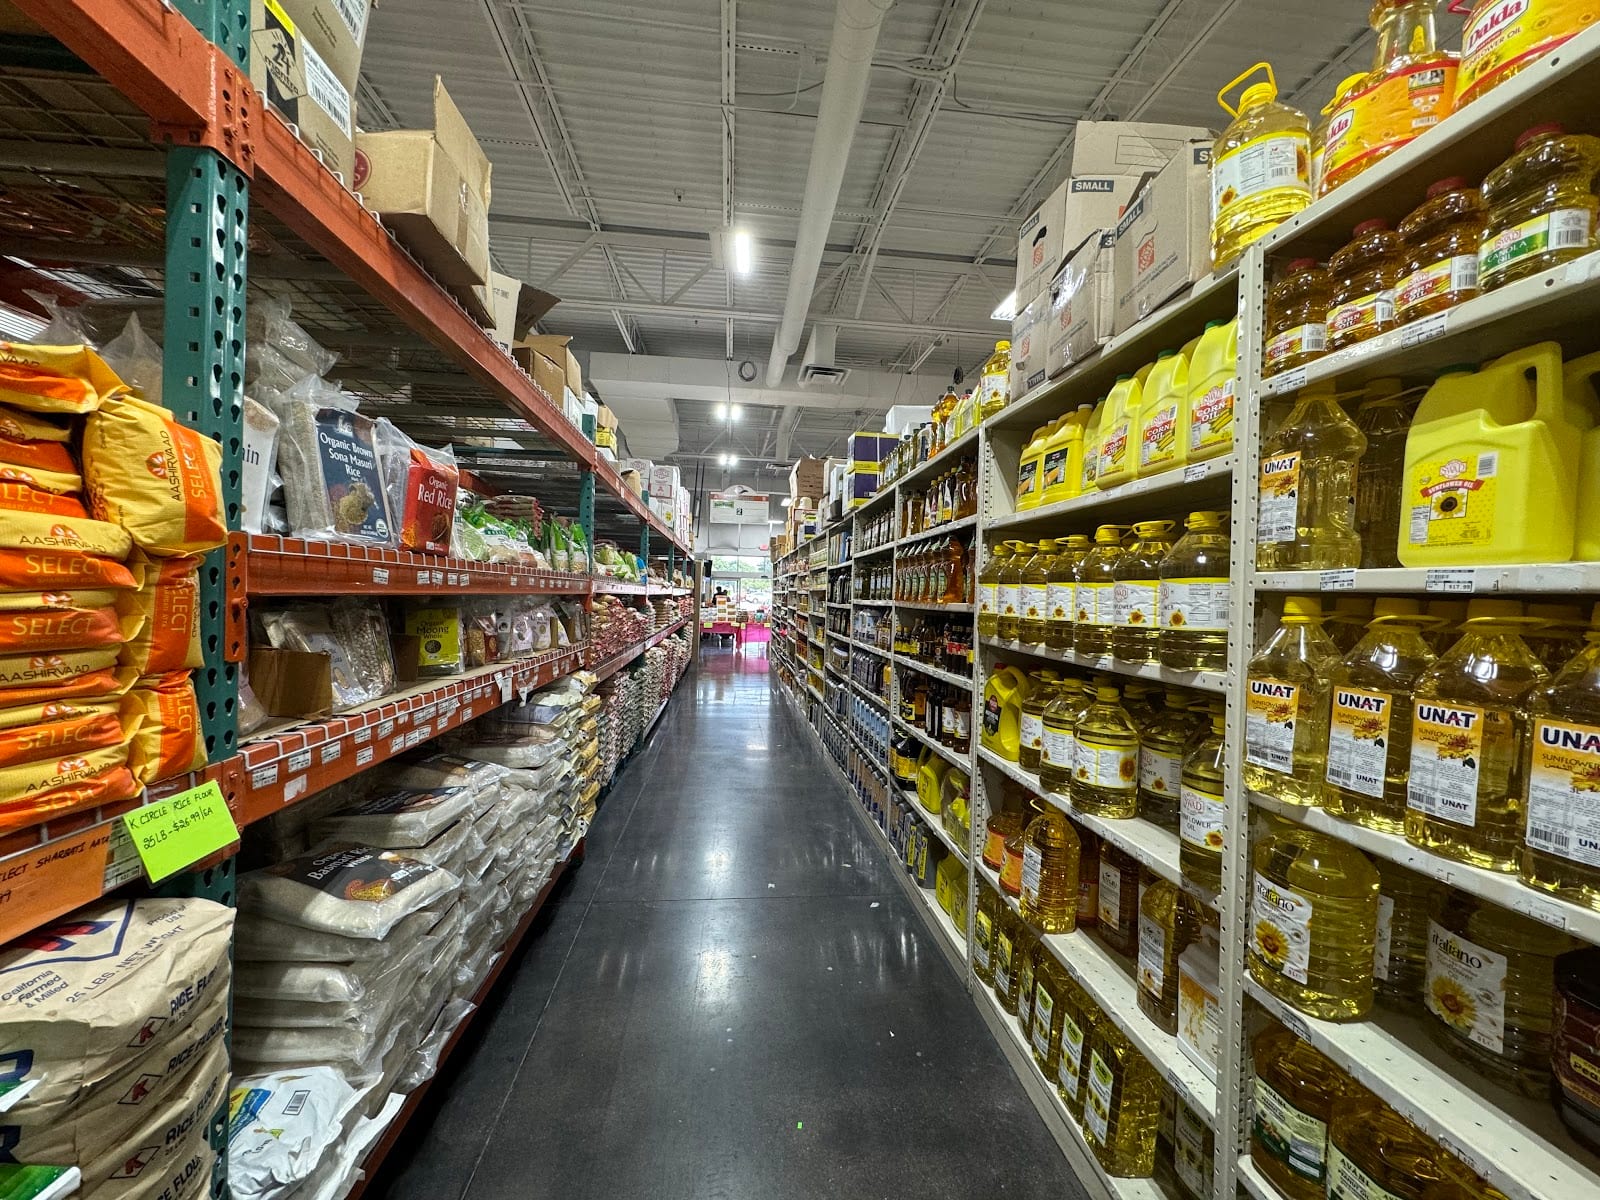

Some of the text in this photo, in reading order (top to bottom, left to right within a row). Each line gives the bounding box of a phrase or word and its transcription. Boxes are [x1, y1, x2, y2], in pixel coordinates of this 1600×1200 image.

[1507, 27, 1522, 39] OIL
[1075, 182, 1110, 191] SMALL
[1117, 204, 1143, 236] SMALL
[1403, 281, 1434, 299] CORN
[1196, 401, 1226, 417] CORN
[1201, 411, 1220, 422] OIL
[1146, 423, 1170, 437] CORN
[1150, 432, 1165, 441] OIL
[320, 432, 374, 458] Organic Brown
[1105, 440, 1122, 452] CORN
[162, 430, 182, 502] AASHIRVAAD
[180, 431, 207, 499] SELECT
[328, 448, 373, 470] Sona Masuri
[1263, 457, 1296, 474] UNAT
[344, 464, 361, 478] Rice
[428, 475, 449, 490] Organic
[1428, 479, 1473, 493] SUNFLOWER OIL
[417, 483, 453, 510] Red Rice
[19, 535, 107, 553] AASHIRVAAD
[11, 616, 93, 636] SELECT
[416, 626, 449, 634] Moong
[0, 664, 90, 683] AASHIRVAAD
[1251, 681, 1295, 699] UNAT
[1338, 692, 1386, 713] UNAT
[1418, 705, 1476, 729] UNAT
[1271, 753, 1289, 763] UNAT
[25, 762, 111, 793] AASHIRVAAD
[1356, 774, 1379, 785] UNAT
[128, 818, 139, 830] K
[140, 805, 168, 826] CIRCLE
[173, 797, 192, 812] RICE
[1441, 798, 1469, 811] UNAT
[306, 854, 356, 880] Basmati
[1257, 881, 1295, 912] italiano
[166, 914, 185, 923] USA
[1432, 929, 1482, 969] italiano
[1, 970, 55, 1001] California
[18, 974, 62, 1003] Farmed
[34, 981, 69, 1003] Milled
[66, 990, 87, 1003] 25
[170, 985, 194, 1016] RICE
[167, 1042, 195, 1074] RICE
[165, 1110, 195, 1145] RICE
[173, 1154, 203, 1192] FLOUR
[1340, 1158, 1369, 1187] AVANI
